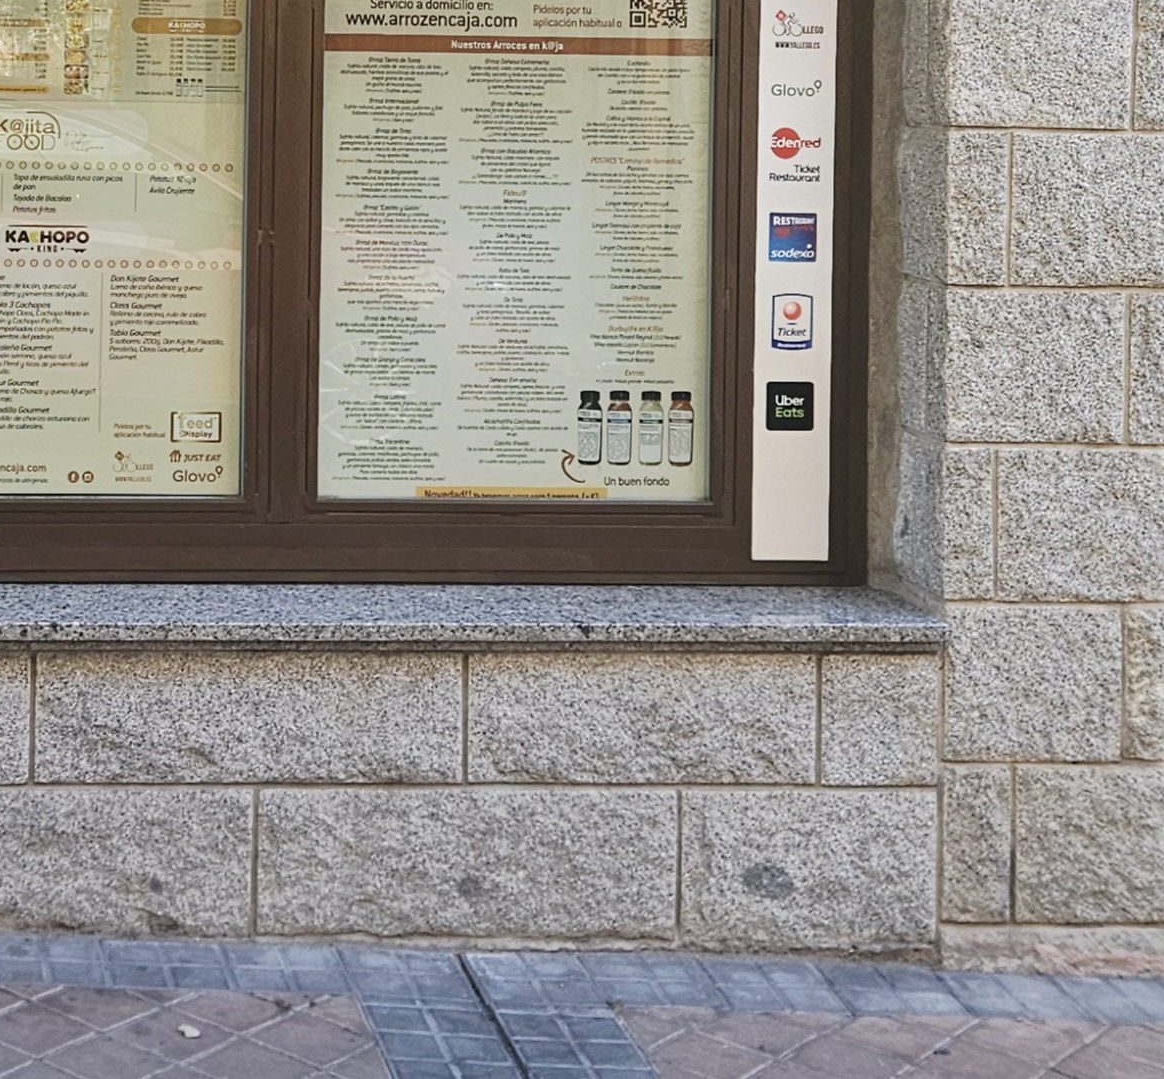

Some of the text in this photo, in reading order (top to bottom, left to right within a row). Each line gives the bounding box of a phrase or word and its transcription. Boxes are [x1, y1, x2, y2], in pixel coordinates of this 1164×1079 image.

[416, 1, 422, 9] a
[566, 7, 580, 16] por
[346, 12, 517, 32] www.arrozencaja.com
[533, 18, 577, 28] aplicación
[579, 19, 615, 27] habitual
[451, 40, 491, 49] Nuestros
[493, 41, 526, 50] Arroces
[771, 84, 815, 96] Glovo
[771, 137, 821, 148] Edenred
[794, 165, 820, 173] Ticket
[770, 173, 820, 182] Restaurant
[5, 230, 89, 243] KACHOPO
[771, 247, 814, 258] sodexo
[778, 328, 806, 336] Ticket
[775, 395, 804, 406] Uber
[776, 408, 804, 417] Eats
[173, 470, 216, 482] Glovo
[604, 477, 669, 486] Un buen fondo
